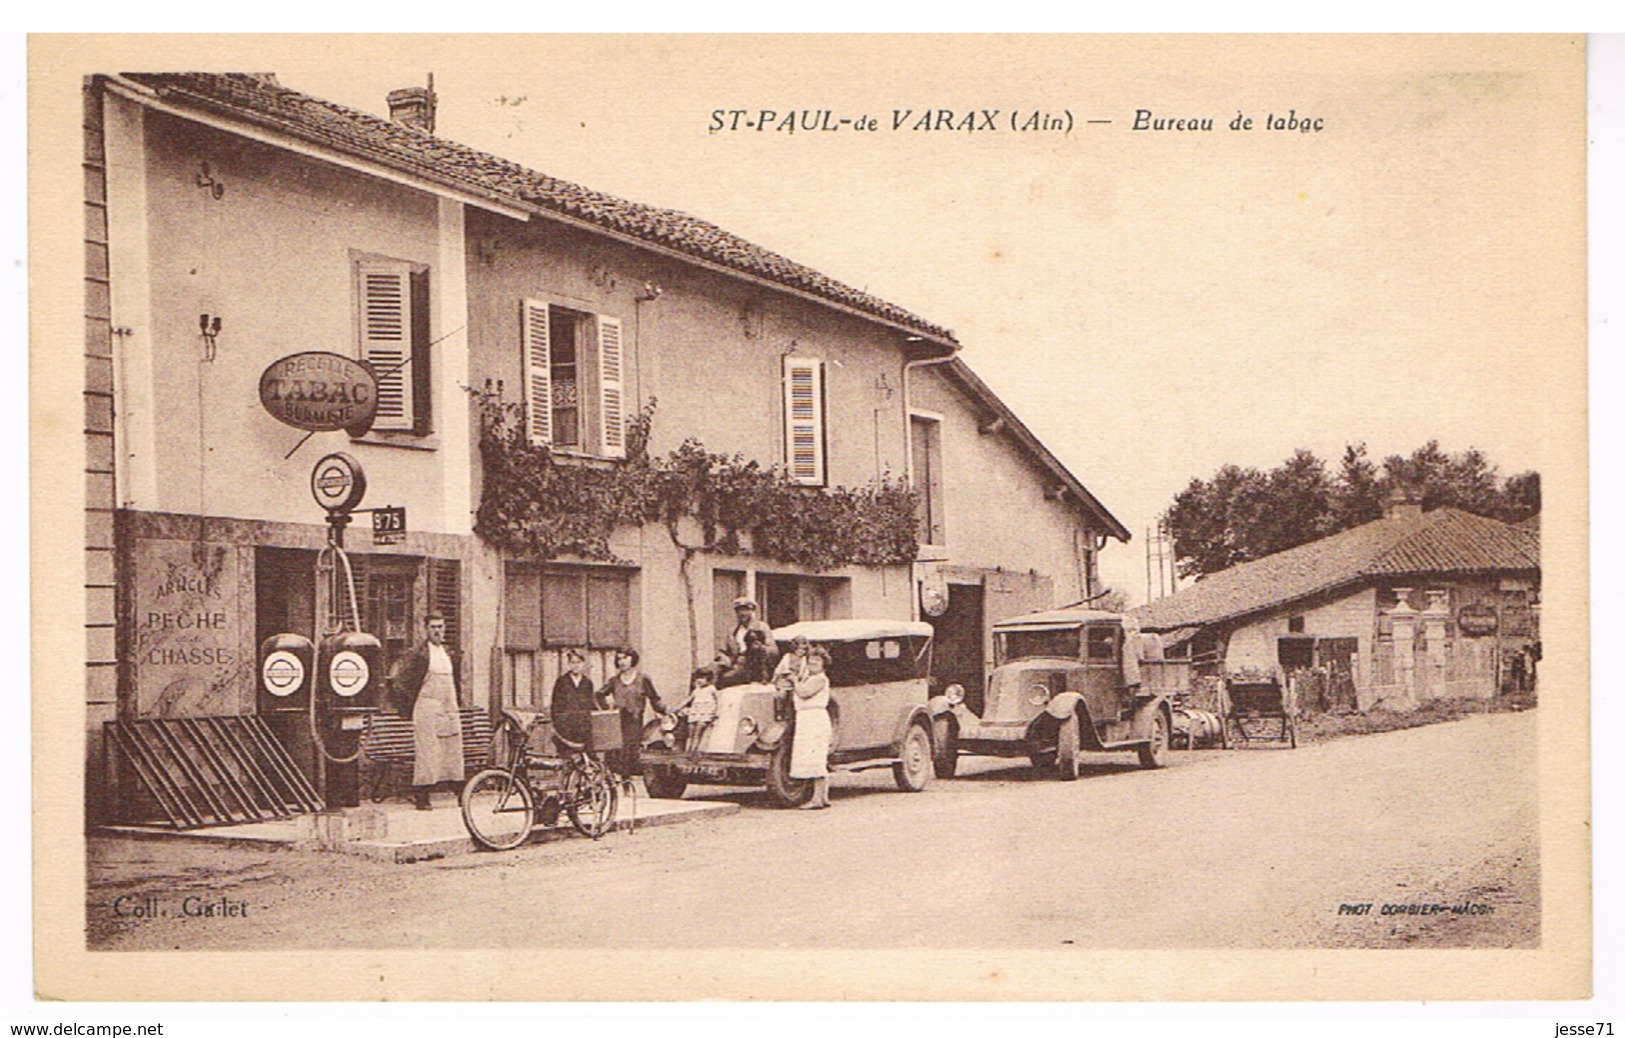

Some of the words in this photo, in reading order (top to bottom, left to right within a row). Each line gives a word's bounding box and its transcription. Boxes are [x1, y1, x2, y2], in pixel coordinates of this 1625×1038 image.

[266, 379, 369, 405] TABAC
[156, 575, 222, 600] ARTICLES
[148, 648, 229, 666] CHASSE
